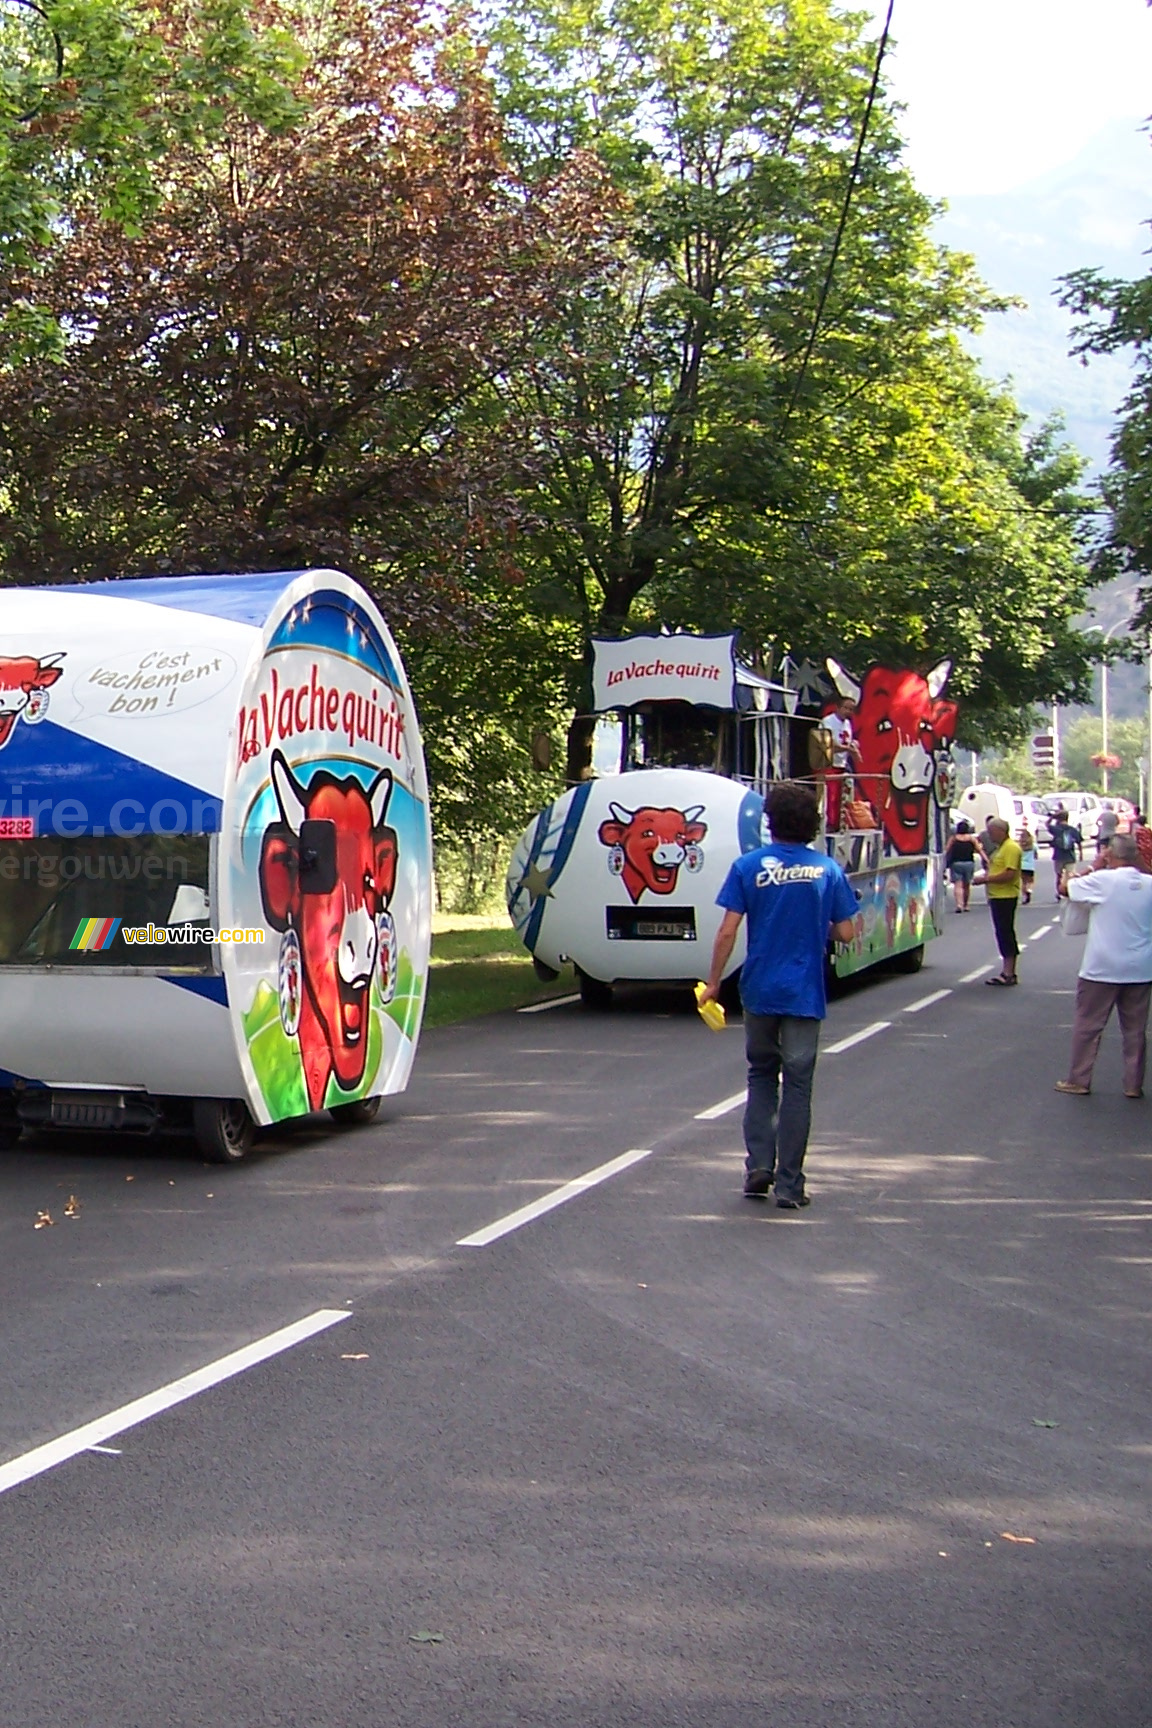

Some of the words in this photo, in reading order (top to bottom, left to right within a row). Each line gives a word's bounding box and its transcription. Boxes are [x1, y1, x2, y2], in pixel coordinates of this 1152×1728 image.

[139, 650, 191, 670] C'est
[625, 660, 674, 679] Vache
[675, 663, 702, 678] qui
[702, 665, 720, 681] rit
[108, 693, 158, 713] bon
[260, 664, 339, 748] Vache
[342, 689, 377, 747] qui
[379, 701, 405, 760] rit
[0, 821, 31, 834] 3282
